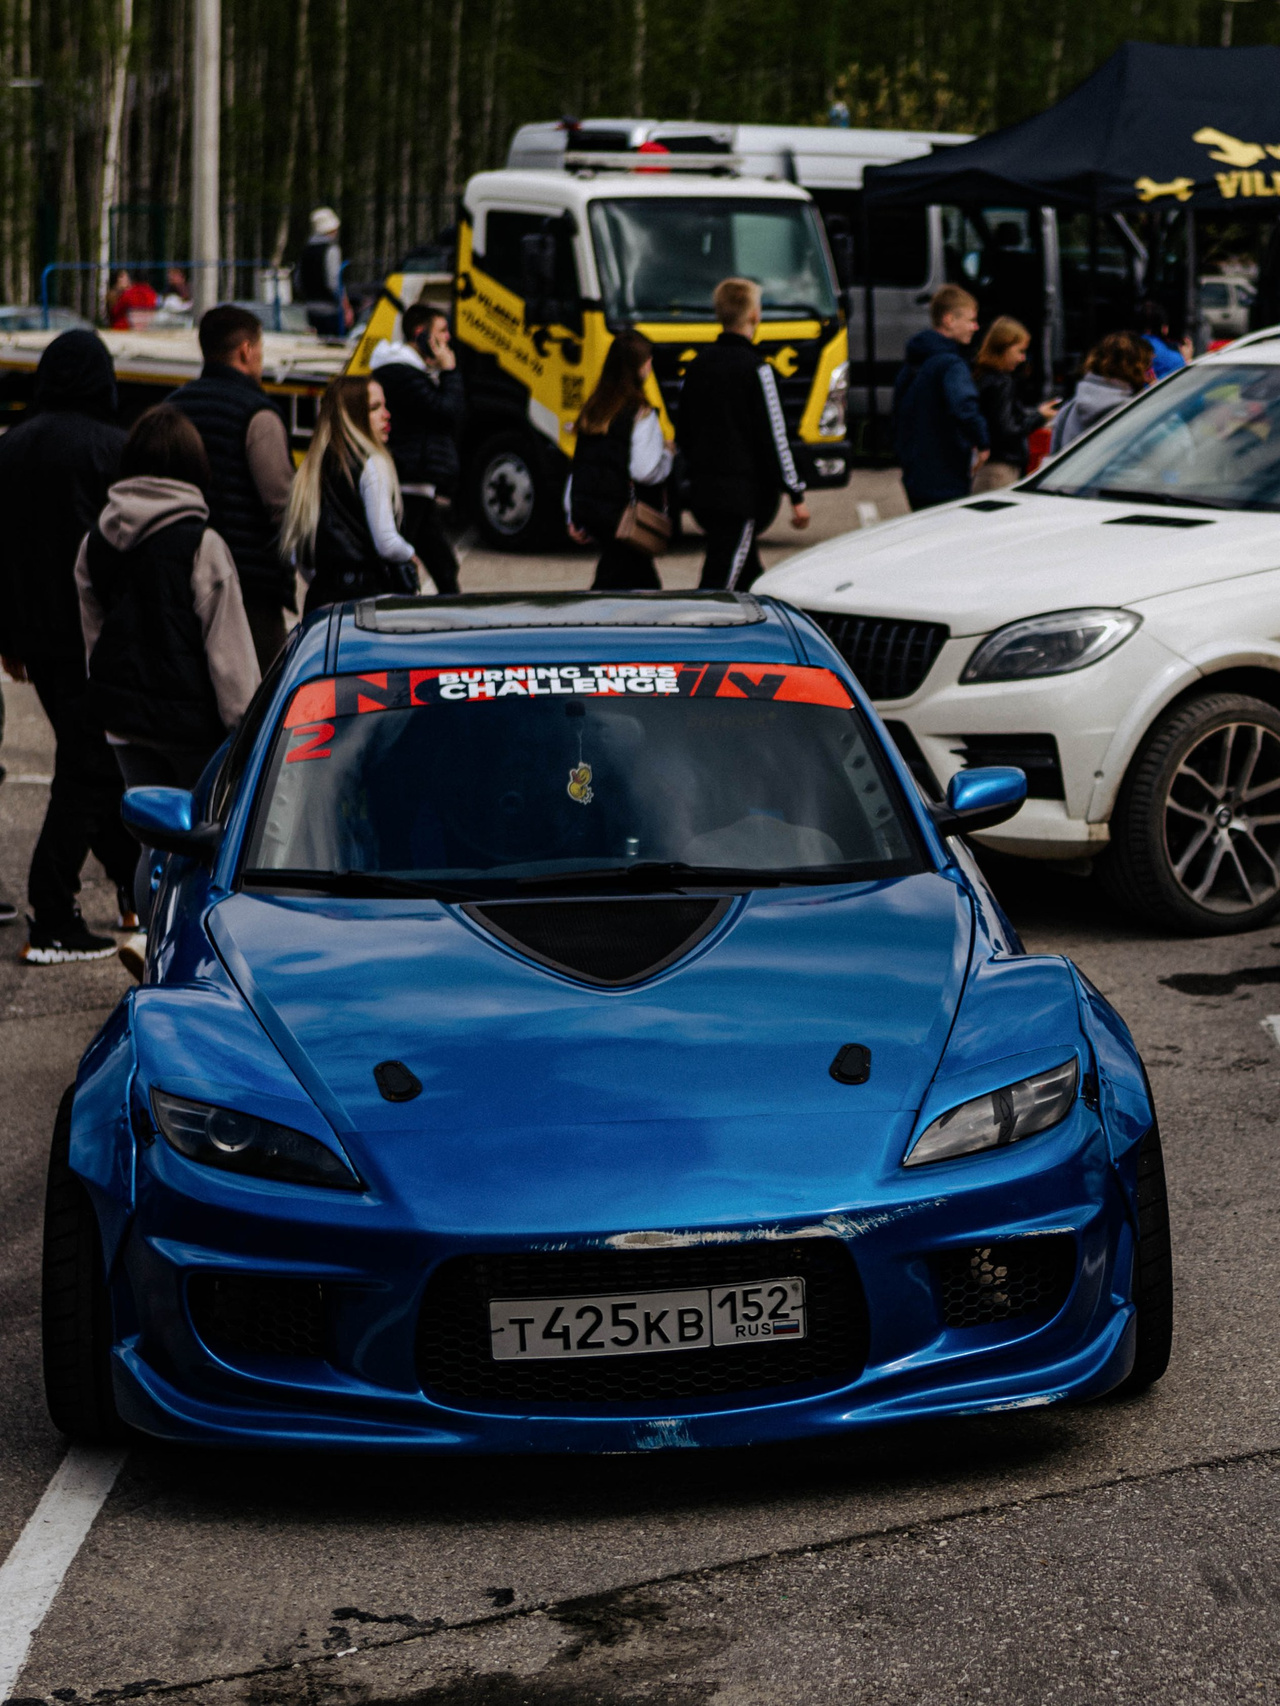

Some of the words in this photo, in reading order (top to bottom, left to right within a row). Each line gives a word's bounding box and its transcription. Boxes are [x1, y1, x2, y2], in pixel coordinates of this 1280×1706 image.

[438, 666, 581, 685] BURNING
[588, 665, 677, 679] TIRES
[439, 677, 680, 700] CHALLENGE
[286, 723, 336, 764] 2
[717, 1285, 790, 1324] 152
[735, 1323, 772, 1338] RUS
